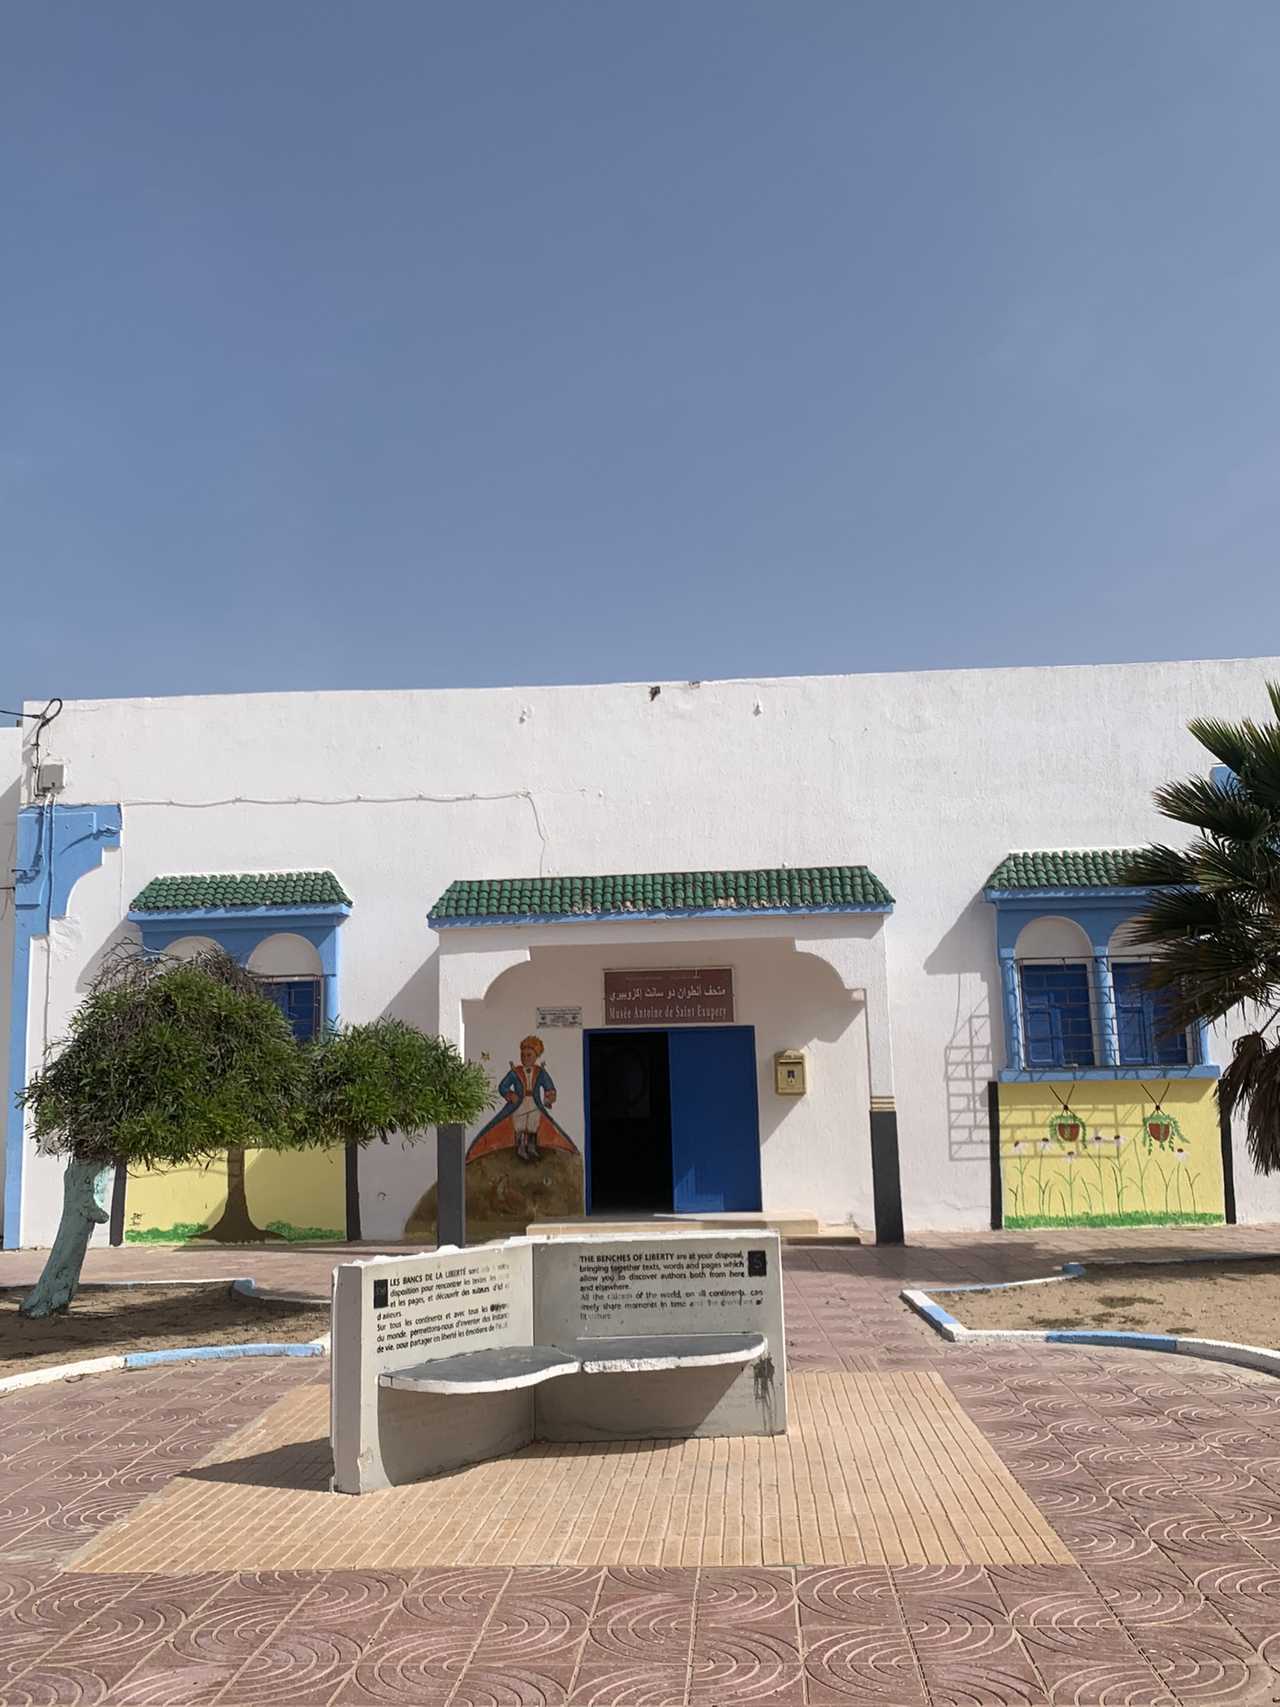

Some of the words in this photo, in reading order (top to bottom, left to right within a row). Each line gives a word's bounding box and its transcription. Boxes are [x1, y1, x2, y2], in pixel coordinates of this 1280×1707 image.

[703, 984, 726, 996] متحف
[633, 1005, 664, 1019] Antoine
[665, 1005, 673, 1018] de
[675, 1005, 695, 1017] Saint
[597, 1254, 631, 1262] BENCHES
[645, 1252, 674, 1261] LIBERTY
[697, 1253, 713, 1262] your
[579, 1265, 609, 1274] bringing
[610, 1264, 640, 1274] together
[663, 1262, 684, 1270] words
[686, 1261, 699, 1269] and
[701, 1262, 721, 1271] pages
[723, 1259, 744, 1268] which
[390, 1278, 401, 1287] LES
[403, 1274, 423, 1284] BANCS
[425, 1273, 433, 1281] DE
[435, 1272, 443, 1280] LA
[602, 1276, 615, 1284] you
[629, 1273, 657, 1281] discover
[660, 1272, 686, 1280] authors
[689, 1270, 706, 1278] both
[729, 1270, 745, 1278] here
[390, 1287, 420, 1299] disposition
[421, 1285, 434, 1294] pour
[635, 1291, 644, 1299] of
[645, 1291, 658, 1299] the
[750, 1289, 764, 1297] can
[603, 1302, 622, 1310] share
[624, 1301, 658, 1309] moments
[377, 1323, 386, 1332] Sur
[389, 1321, 402, 1330] tous
[415, 1314, 443, 1326] continents
[376, 1334, 385, 1343] du
[376, 1345, 385, 1354] de
